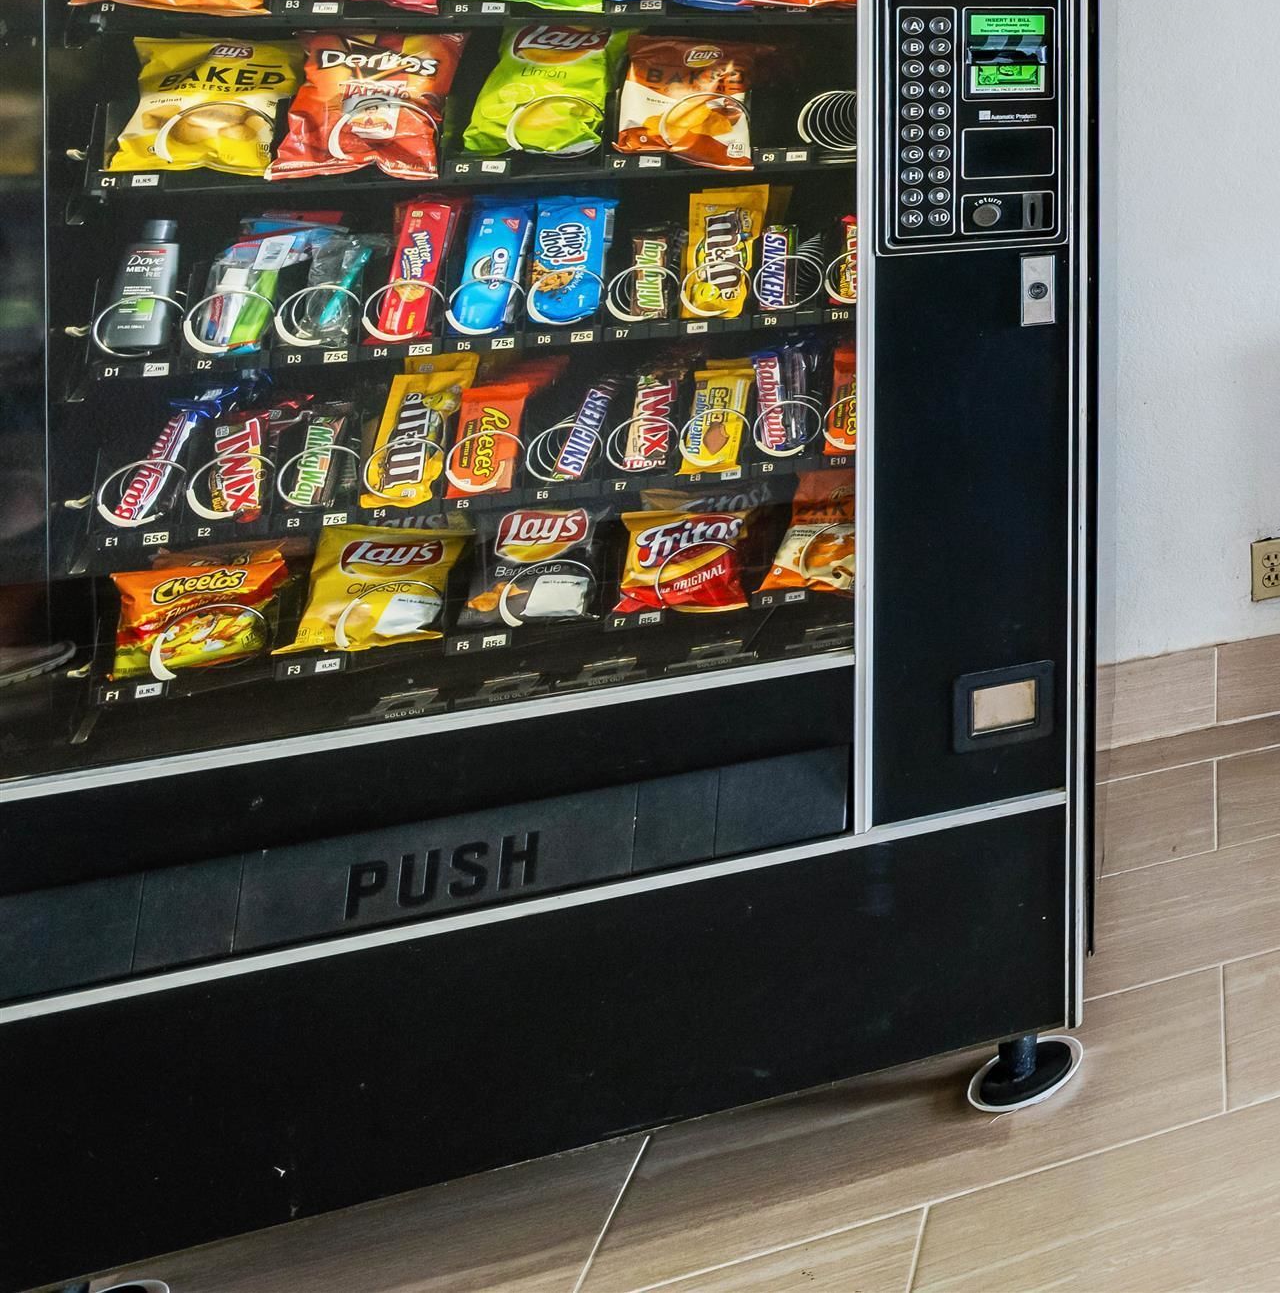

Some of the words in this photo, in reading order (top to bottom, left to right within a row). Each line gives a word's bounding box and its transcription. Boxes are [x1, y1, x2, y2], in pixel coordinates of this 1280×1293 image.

[615, 4, 627, 13] B7
[910, 22, 920, 30] A
[910, 43, 919, 51] B
[938, 43, 945, 51] 2
[321, 50, 440, 76] Doritos
[521, 66, 568, 79] Limón
[910, 64, 919, 72] C
[159, 67, 286, 88] BAKED
[201, 84, 230, 92] LESS
[910, 86, 919, 94] D
[938, 85, 945, 93] 4
[938, 107, 945, 115] 5
[910, 129, 918, 137] F
[909, 150, 919, 158] G
[937, 149, 944, 157] 7
[762, 154, 775, 162] C9
[456, 164, 469, 173] C5
[613, 160, 626, 168] C7
[909, 172, 918, 180] H
[101, 177, 116, 187] C1
[909, 193, 917, 201] J
[937, 192, 944, 200] 9
[974, 197, 1002, 206] return
[934, 213, 947, 221] 10
[559, 224, 584, 256] Chips
[412, 231, 433, 263] Nutter
[636, 240, 667, 266] Way
[128, 255, 165, 265] Dove
[760, 234, 787, 307] SNICKERS
[637, 265, 666, 308] Milky
[831, 311, 849, 320] D10
[764, 317, 777, 326] D9
[616, 330, 629, 338] D7
[538, 336, 551, 344] D6
[457, 342, 471, 350] D5
[374, 349, 388, 357] D4
[288, 355, 301, 363] D3
[197, 361, 212, 369] D2
[105, 368, 119, 376] D1
[758, 358, 779, 403] Baby
[640, 379, 678, 457] TWIX
[558, 389, 609, 474] SNICKERS
[473, 407, 510, 477] Reese's
[297, 425, 334, 471] Milky
[215, 418, 262, 512] TWIX
[831, 457, 846, 465] E10
[762, 463, 773, 471] E9
[690, 474, 700, 482] E8
[288, 468, 326, 504] Way
[615, 482, 627, 490] E7
[537, 491, 549, 499] E6
[457, 500, 469, 508] E5
[373, 509, 386, 518] E4
[287, 518, 300, 527] E3
[197, 528, 211, 536] E2
[502, 513, 583, 546] Lay's
[105, 537, 118, 546] E1
[636, 517, 744, 567] Fritos
[346, 541, 439, 566] Lay's
[495, 564, 562, 577] Barbecue
[673, 564, 726, 591] ORIGINAL
[154, 570, 247, 603] Cheetos
[762, 596, 773, 604] F9
[614, 618, 626, 627] F7
[457, 641, 469, 650] F5
[287, 665, 300, 674] F3
[587, 678, 608, 686] SOLD
[105, 691, 120, 700] F1
[384, 711, 407, 719] SOLD
[408, 708, 425, 716] OUT
[342, 830, 540, 921] PUSH
